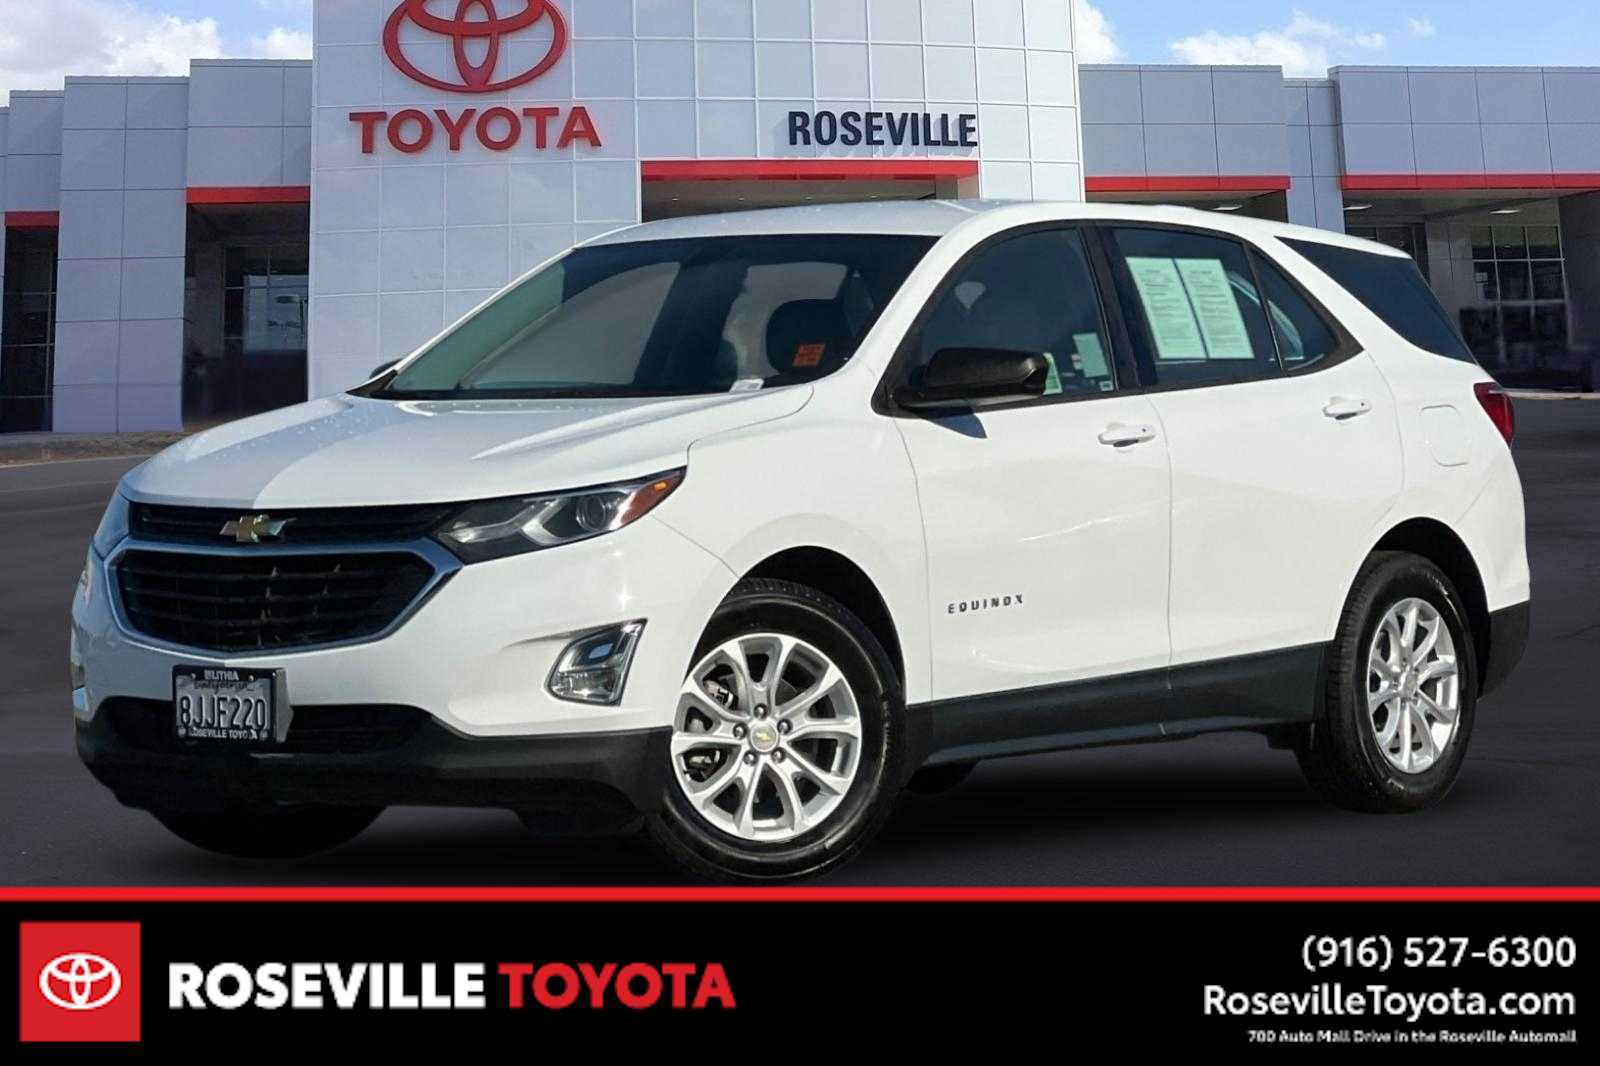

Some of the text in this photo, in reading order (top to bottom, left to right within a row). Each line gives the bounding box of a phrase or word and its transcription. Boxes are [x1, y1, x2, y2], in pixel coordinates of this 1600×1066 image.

[349, 106, 602, 153] TOYOTA
[788, 111, 978, 147] ROSEVILLE
[947, 594, 1023, 614] EQUINOX
[180, 695, 267, 728] 8JJF220
